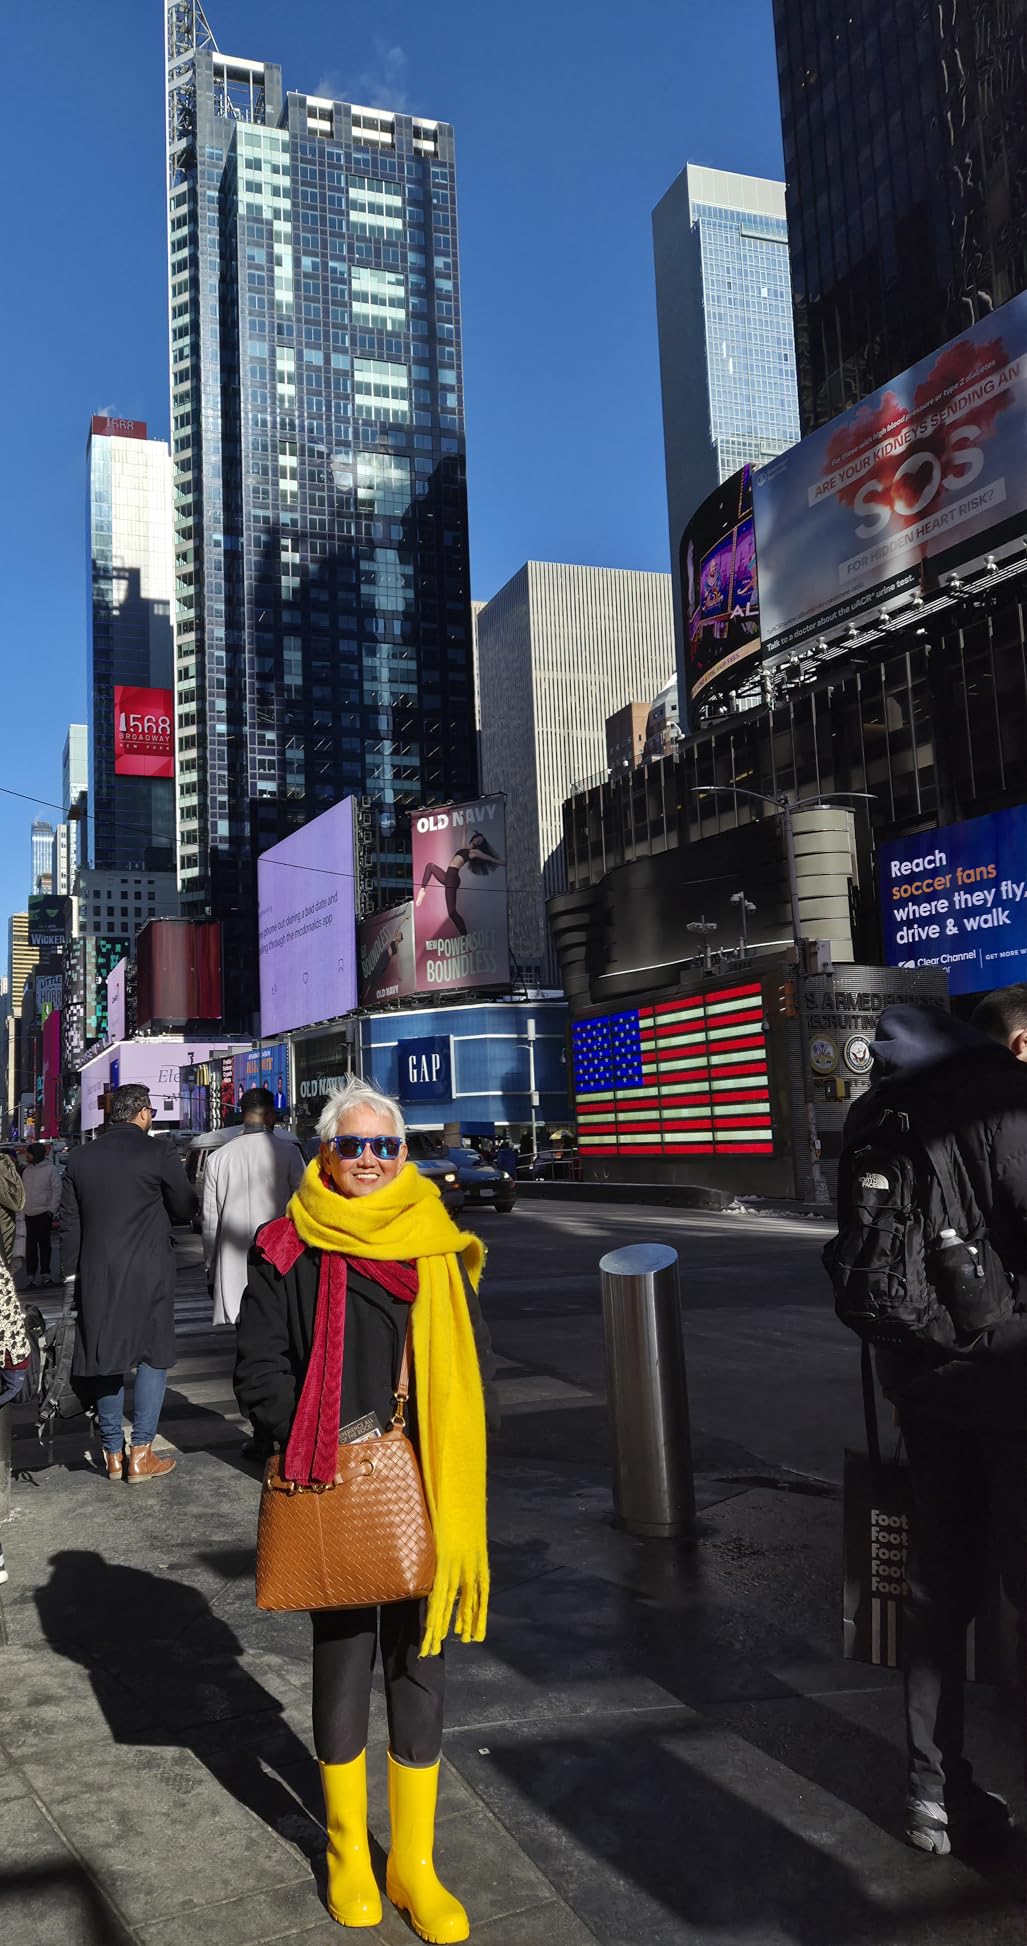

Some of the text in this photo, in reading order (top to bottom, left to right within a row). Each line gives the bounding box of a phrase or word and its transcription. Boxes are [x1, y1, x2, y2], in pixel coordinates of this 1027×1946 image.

[815, 362, 1020, 497] ARE YOUR KIDNEYS SENDING AN
[887, 415, 905, 431] blood
[853, 424, 985, 540] SOS
[847, 489, 995, 574] FOR HIDDEN HEART RISK?
[767, 638, 781, 652] Talk
[794, 620, 817, 638] doctor
[817, 611, 838, 627] about
[837, 605, 850, 617] the
[875, 582, 896, 598] urine
[896, 574, 915, 588] test.
[119, 712, 170, 734] 1568
[119, 733, 170, 742] BROADWAY
[417, 803, 497, 833] OLD NAVY
[890, 849, 947, 878] Reach
[892, 863, 998, 900] soccer fans
[263, 924, 277, 939] phone
[278, 918, 286, 930] out
[286, 911, 301, 926] during
[305, 902, 315, 917] bad
[315, 898, 328, 912] date
[328, 890, 338, 906] and
[893, 902, 949, 922] where
[953, 888, 996, 910] they
[268, 934, 286, 950] through
[286, 931, 294, 943] the
[294, 917, 322, 938] mcdonalds
[322, 914, 333, 928] app
[896, 907, 1012, 945] drive & walk
[437, 929, 497, 957] POWERSOFT
[999, 949, 1019, 958] MORE
[426, 949, 497, 983] BOUNDLESS
[917, 949, 977, 967] Clear Channel
[40, 976, 62, 988] LITTLE
[376, 984, 399, 999] OLD NAVY
[822, 991, 882, 1012] ARMED
[408, 1053, 440, 1083] GAP
[300, 1080, 318, 1098] OLD
[871, 1509, 910, 1530] Foot
[871, 1526, 909, 1546] Foot
